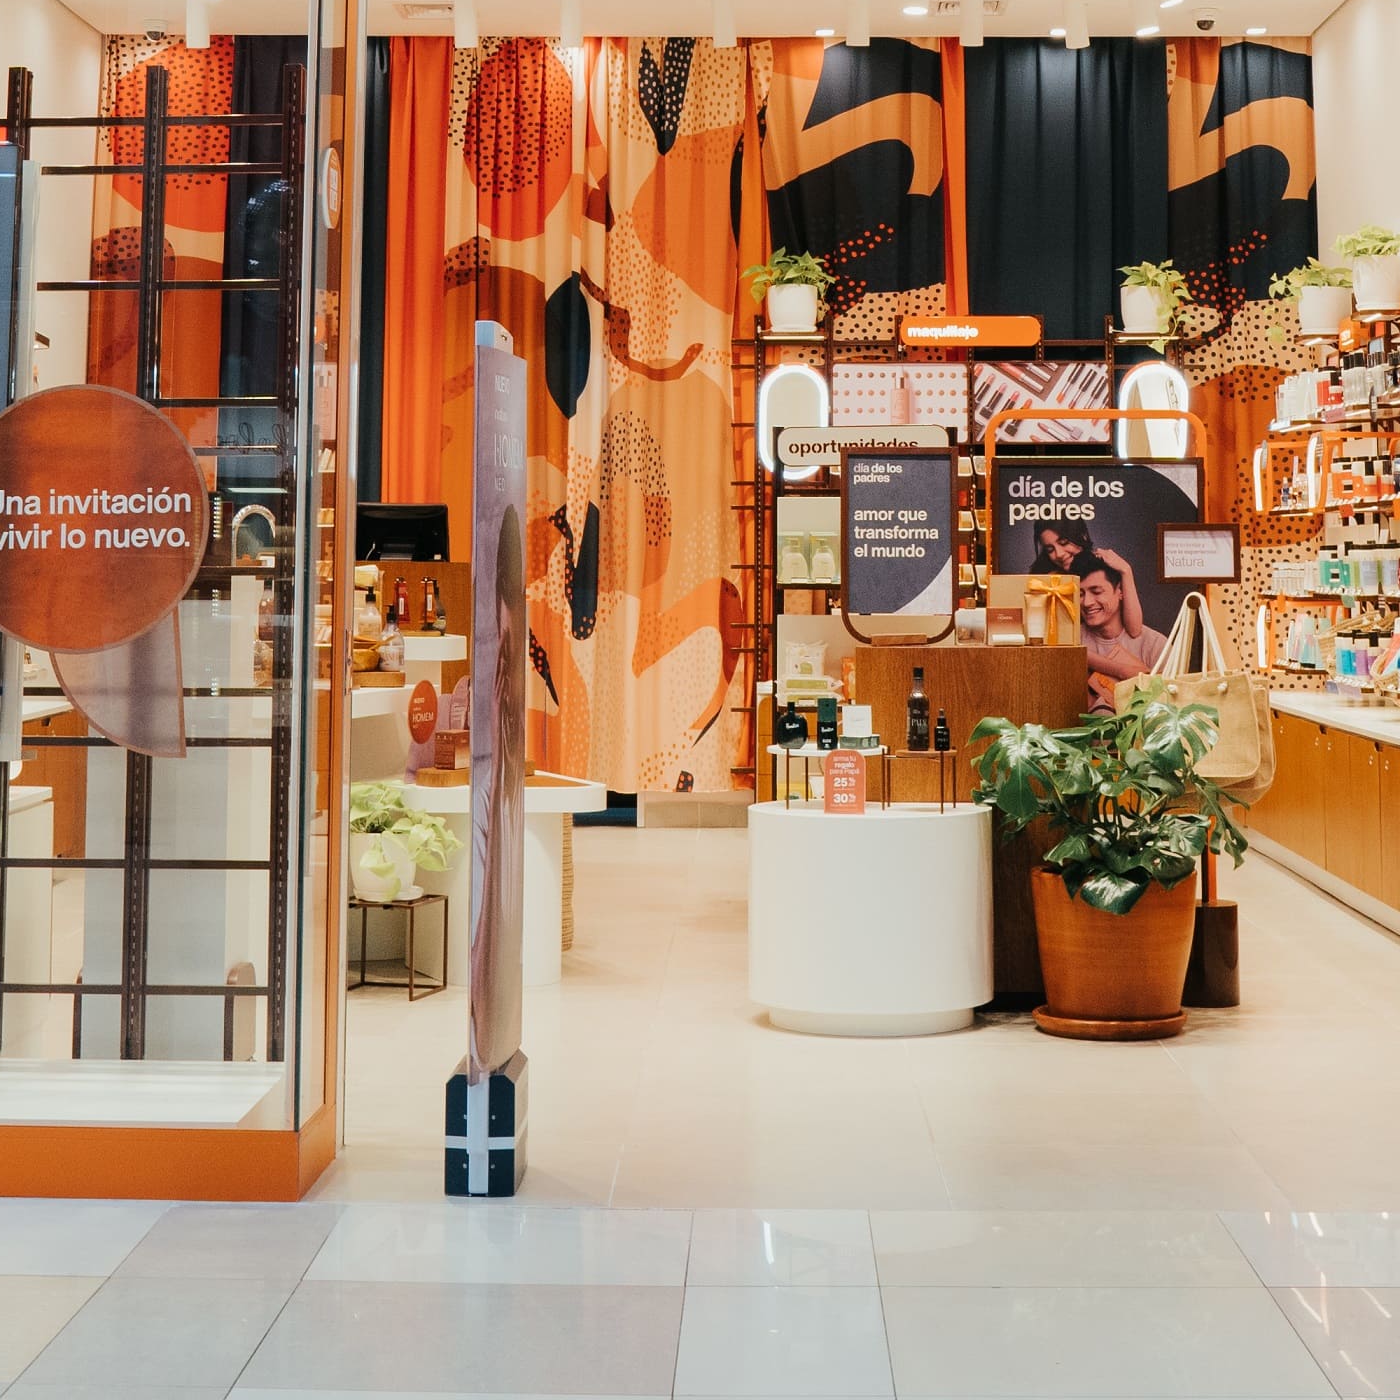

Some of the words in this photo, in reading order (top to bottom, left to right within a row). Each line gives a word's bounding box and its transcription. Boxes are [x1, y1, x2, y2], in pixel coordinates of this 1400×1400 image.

[853, 463, 869, 473] día
[871, 463, 885, 473] de
[887, 463, 903, 473] los
[853, 473, 890, 485] padres
[1008, 475, 1046, 498] día
[1050, 475, 1083, 498] de
[1088, 475, 1124, 498] los
[50, 487, 192, 515] invitación
[854, 509, 895, 521] amor
[897, 509, 928, 524] que
[1008, 499, 1096, 526] padres
[60, 523, 86, 549] lo
[94, 526, 191, 549] nuevo.
[854, 525, 939, 539] transforma
[854, 543, 868, 557] el
[871, 543, 926, 557] mundo
[1166, 556, 1205, 568] Natura
